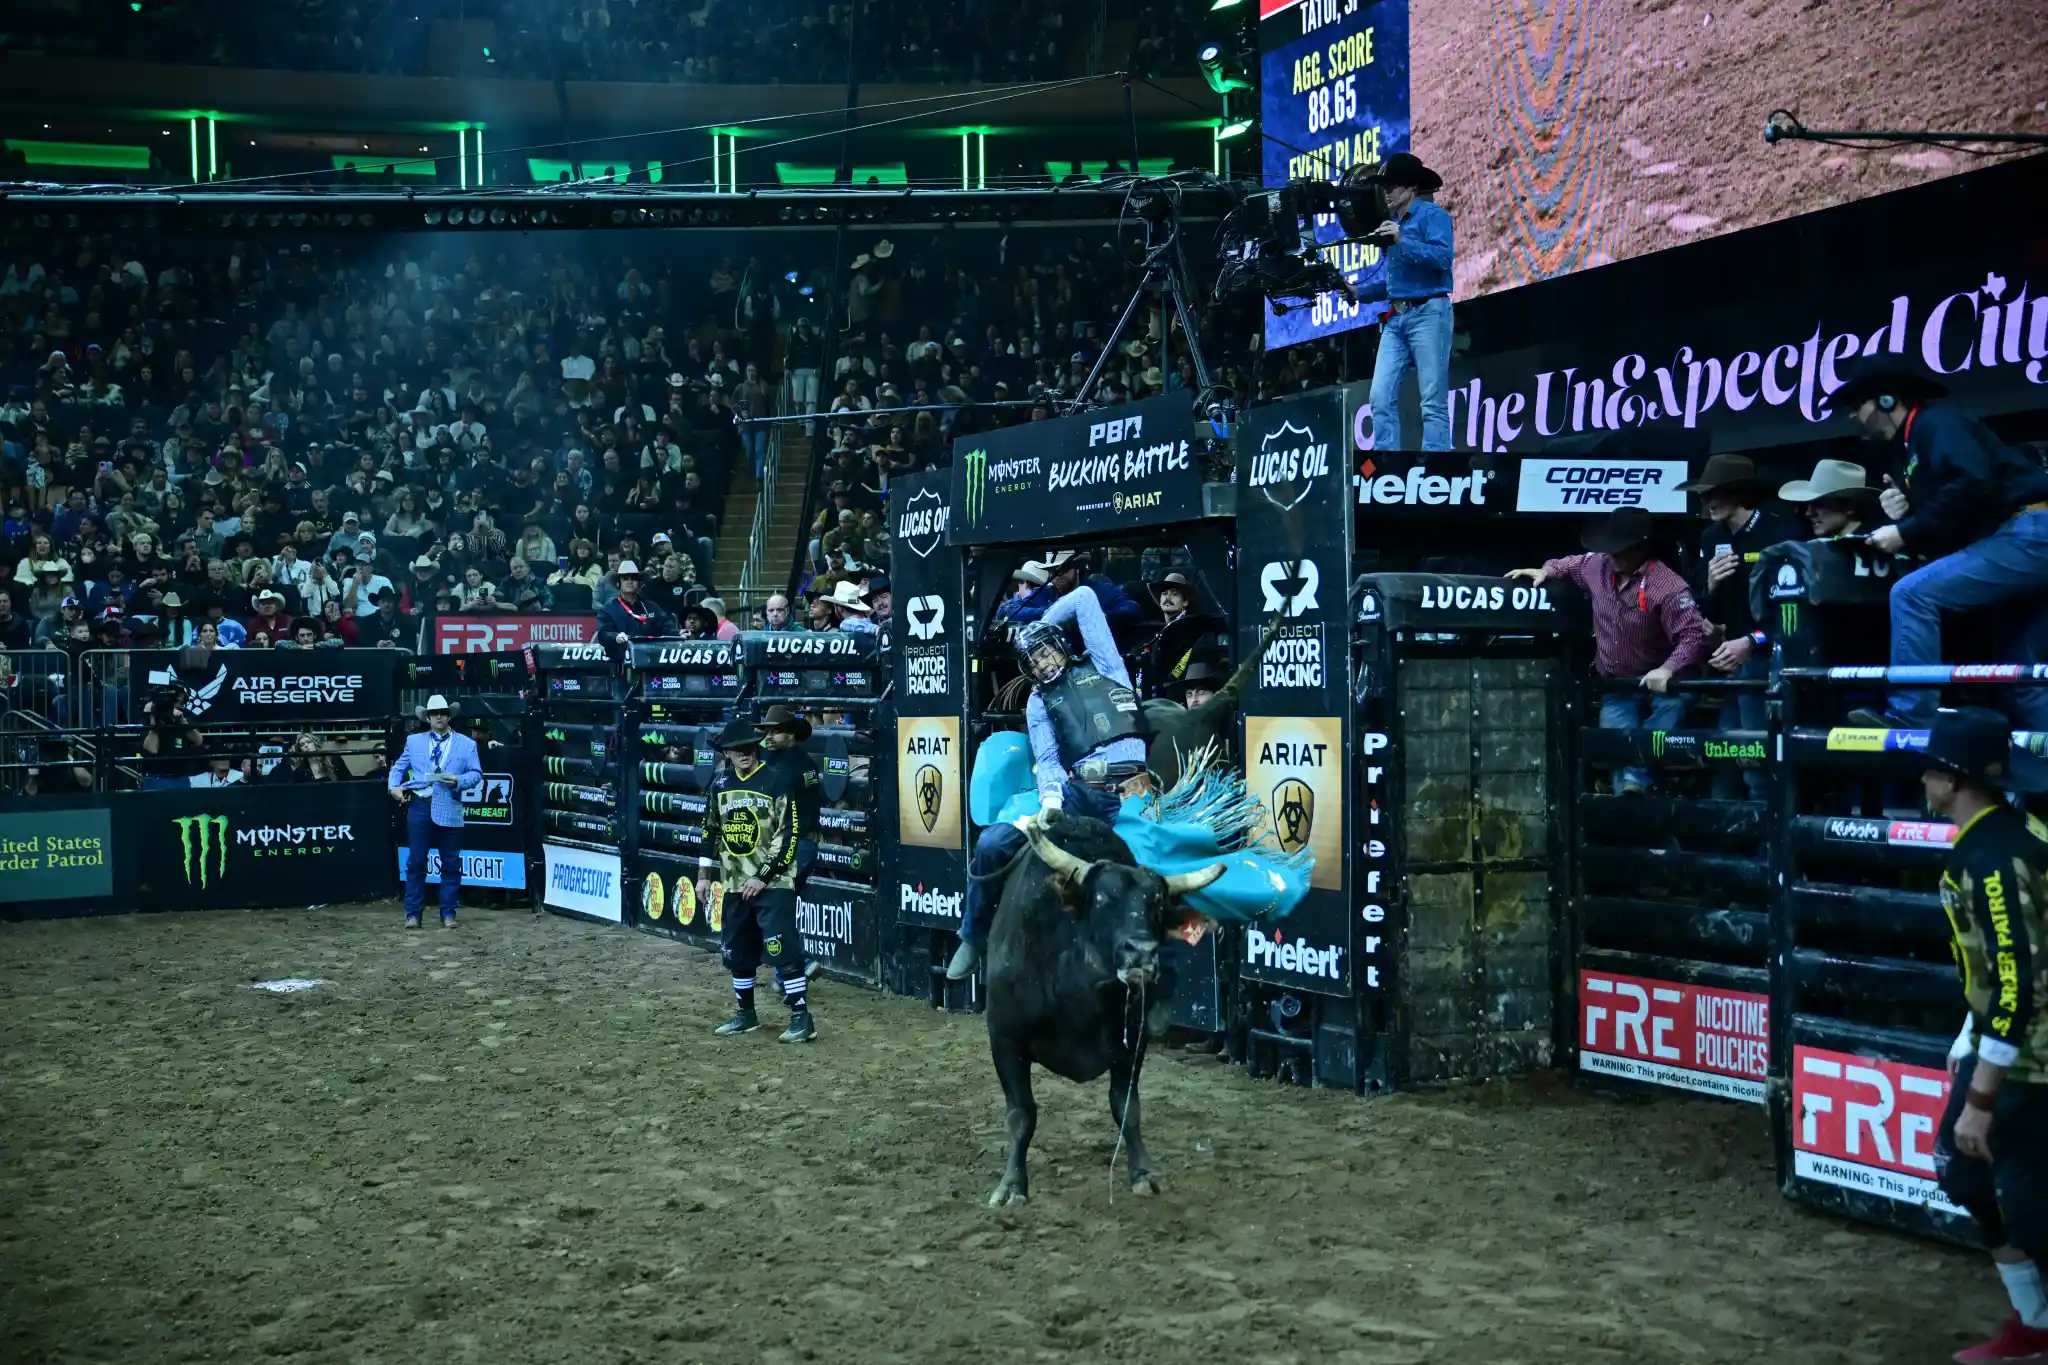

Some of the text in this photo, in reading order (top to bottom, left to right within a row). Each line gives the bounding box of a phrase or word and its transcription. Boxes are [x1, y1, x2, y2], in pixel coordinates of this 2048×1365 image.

[1293, 27, 1374, 95] AGG. SCORE
[1308, 74, 1357, 134] 88.65
[1289, 126, 1381, 181] EVENT PLACE
[1089, 415, 1142, 447] PBR
[988, 456, 1041, 483] MONSTER
[1049, 454, 1120, 493] BUCKING
[1124, 439, 1190, 483] BATTLE
[1249, 449, 1301, 487] LUCAS
[1303, 443, 1329, 477] OIL
[1545, 467, 1664, 485] COOPER
[995, 481, 1032, 494] ENERGY
[1353, 459, 1487, 505] iefert
[1124, 491, 1162, 510] ARIAT
[1560, 488, 1642, 505] TIRES
[899, 508, 932, 539] LUCAS
[1421, 585, 1552, 611] LUCAS OIL
[442, 624, 583, 654] FRE NICOTINE
[1262, 624, 1320, 640] POJECT
[659, 648, 713, 665] LUCAS
[766, 638, 857, 655] LUCAS OIL
[908, 643, 946, 656] PROJECT
[1263, 638, 1321, 664] MOTOR
[908, 655, 946, 676] MOTOR
[1263, 663, 1321, 688] RACING
[232, 675, 363, 691] AIR FORCE
[908, 675, 947, 694] RACING
[240, 689, 355, 704] RESERVE
[907, 737, 950, 756] ARIAT
[1259, 743, 1327, 767] ARIAT
[1704, 740, 1766, 758] Unleash
[461, 779, 510, 803] BR
[481, 807, 508, 818] BEAST
[236, 824, 355, 846] MONSTER
[725, 823, 755, 834] BORDER
[1831, 820, 1879, 839] Kubota
[2, 836, 101, 853] ited States
[254, 846, 336, 857] ENERGY
[0, 849, 103, 870] rder Patrol
[552, 862, 612, 899] PROGRESSIVE
[901, 882, 962, 918] Priefert
[1983, 869, 2014, 947] PATROL
[795, 895, 852, 945] PENDLETON
[803, 937, 836, 957] WHISKY
[1248, 929, 1340, 980] Priefert
[1586, 978, 1681, 1061] FRE
[1695, 994, 1768, 1038] NICOTINE
[1695, 1031, 1768, 1077] POUCHES
[1591, 1055, 1766, 1099] WARNING: This product contains nicotin
[1802, 1057, 1943, 1173] FRE
[1812, 1160, 1951, 1205] WARNING: This produc
